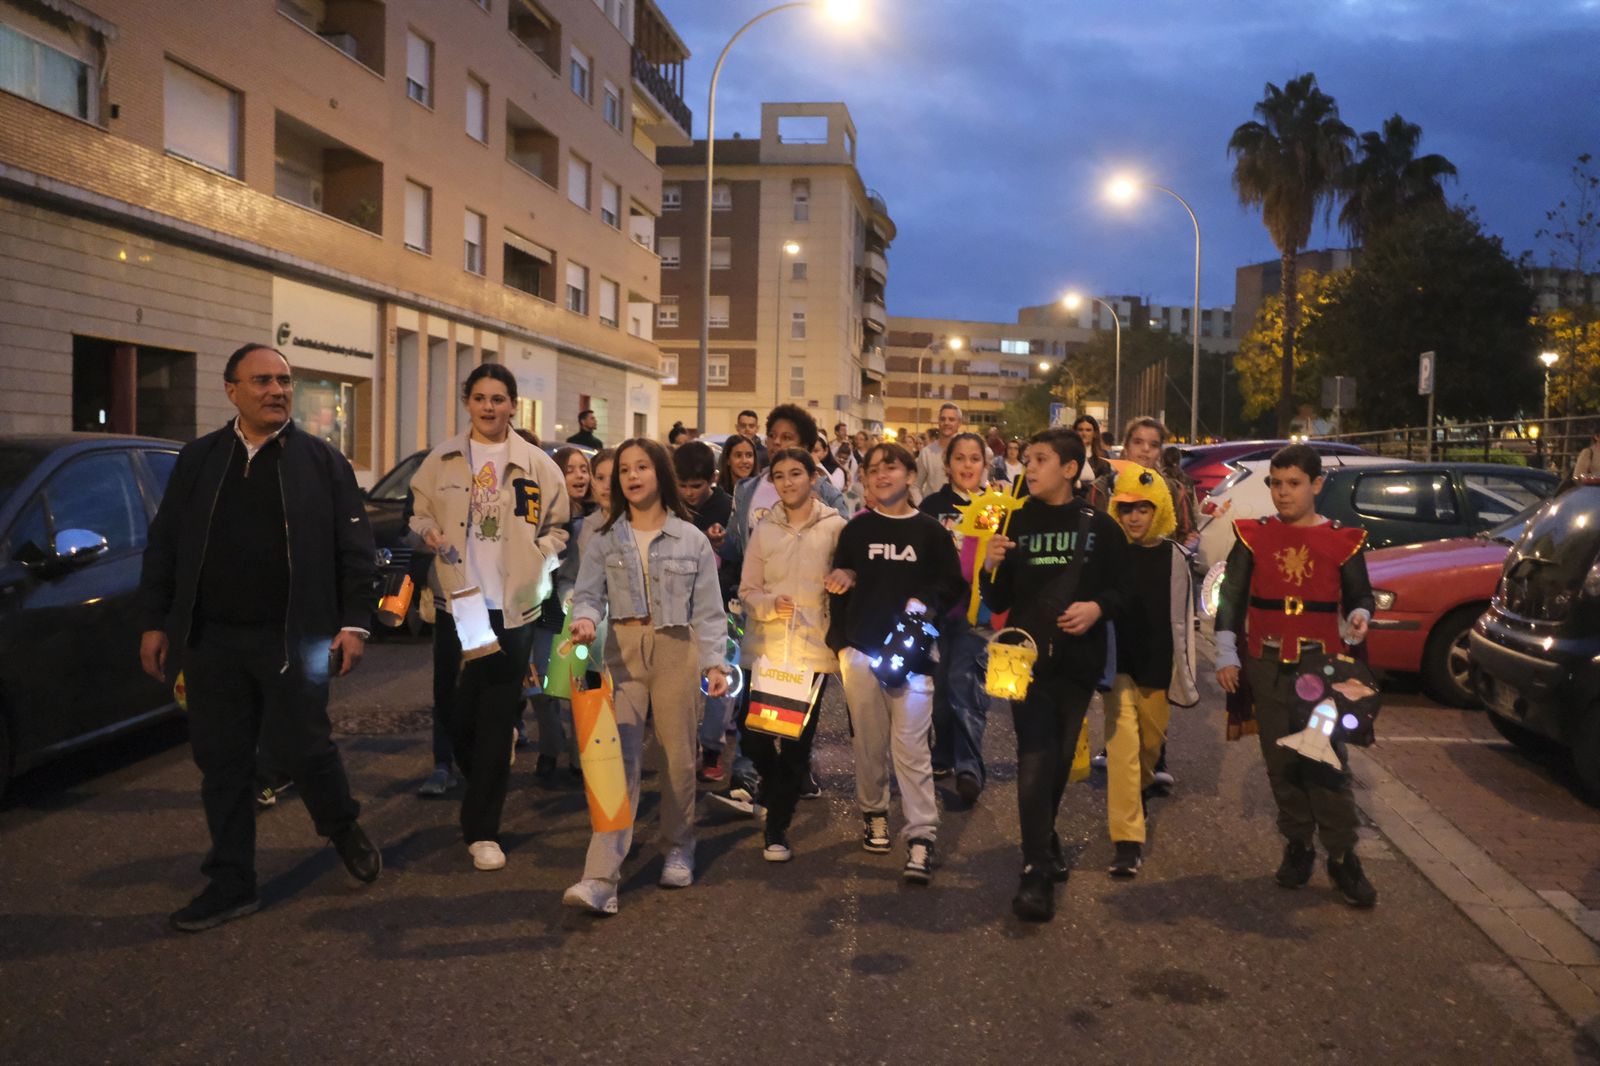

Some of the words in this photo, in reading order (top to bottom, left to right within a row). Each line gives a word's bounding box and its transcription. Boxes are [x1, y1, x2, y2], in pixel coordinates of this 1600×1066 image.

[1421, 358, 1430, 388] P
[868, 543, 917, 562] FILA
[759, 667, 804, 685] LATERNE
